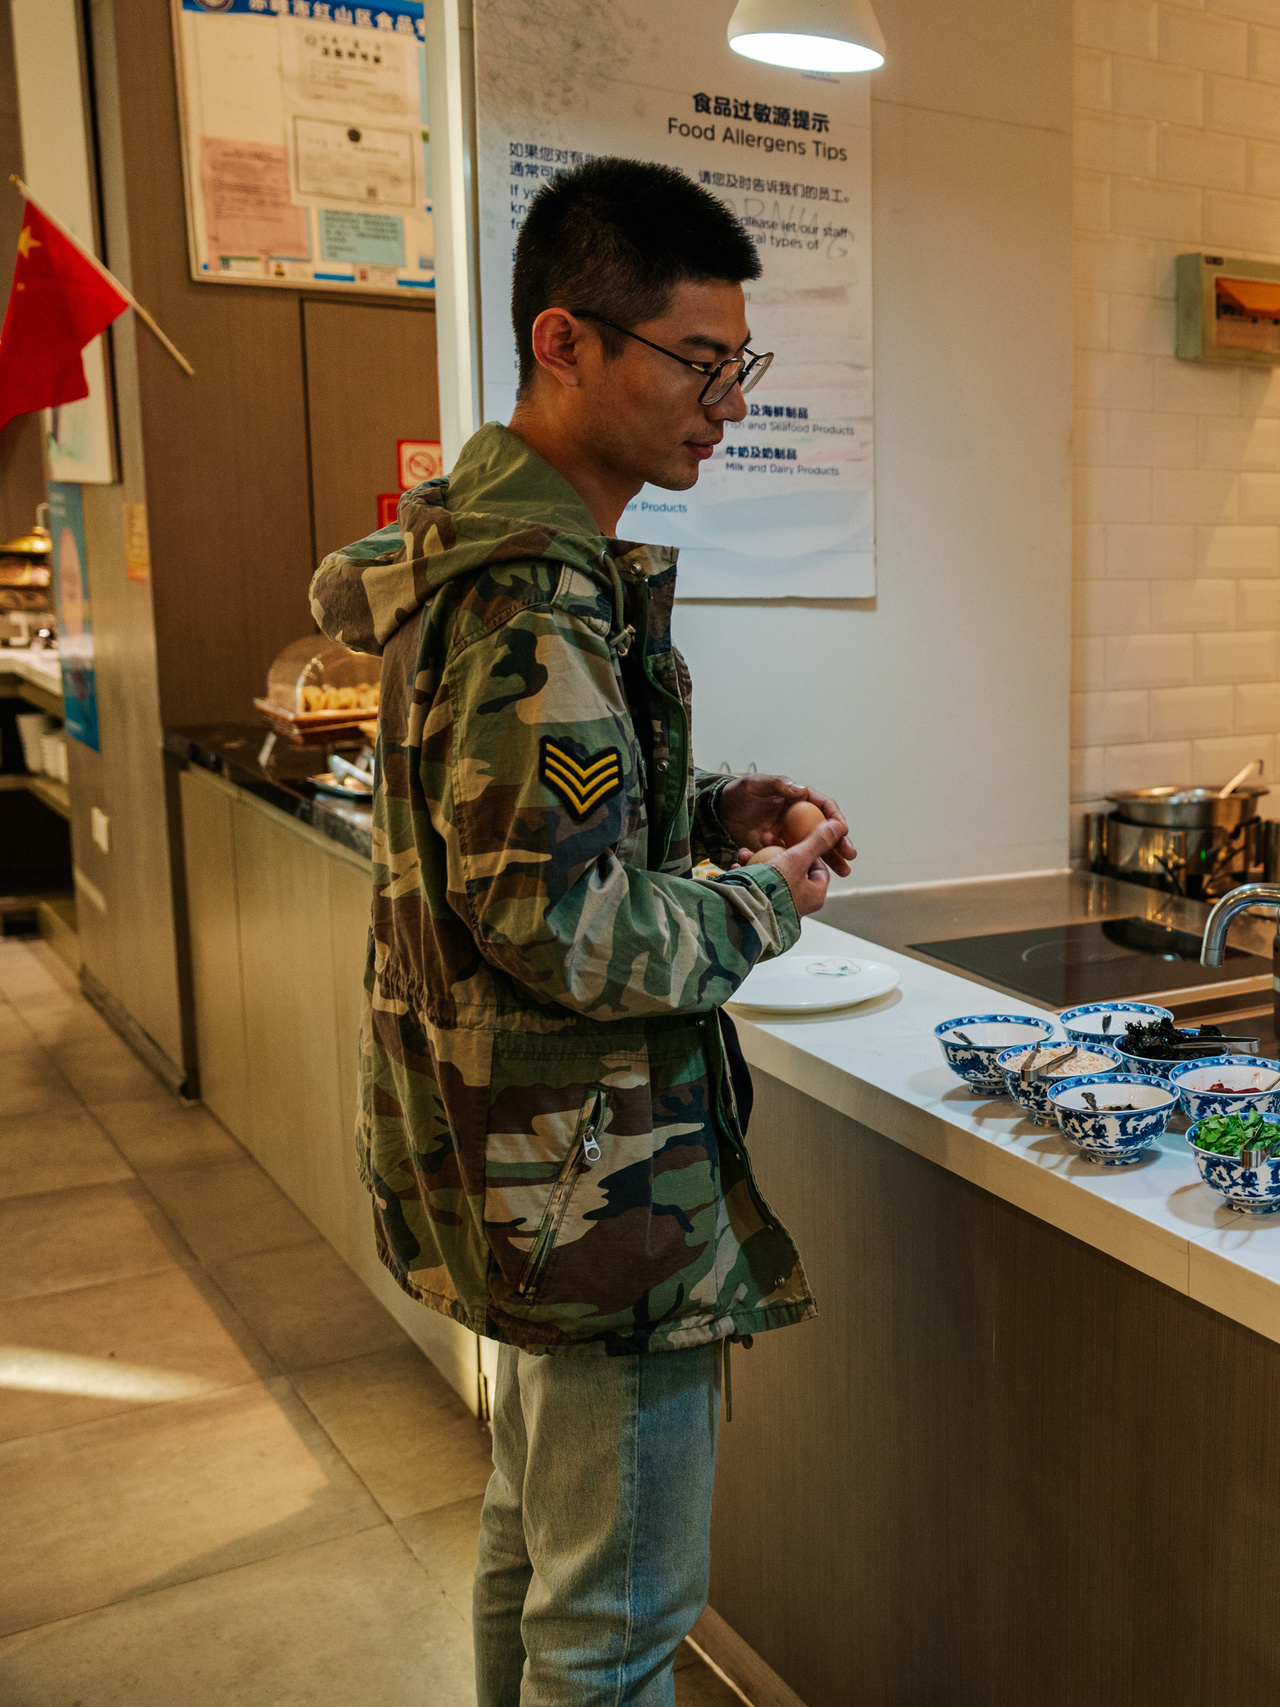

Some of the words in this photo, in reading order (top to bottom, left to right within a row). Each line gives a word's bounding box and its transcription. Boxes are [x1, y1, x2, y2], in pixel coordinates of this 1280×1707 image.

[693, 92, 830, 133] 食品过敏源提示
[667, 117, 715, 141] Food
[722, 127, 806, 156] Allergens
[813, 140, 848, 162] Tips
[523, 188, 540, 199] yo
[782, 220, 796, 232] let
[801, 224, 819, 235] our
[823, 226, 848, 239] staff
[770, 234, 803, 249] types
[807, 239, 819, 250] of
[746, 404, 809, 420] 及海鲜制品
[748, 421, 767, 431] and
[770, 421, 810, 433] Seafood
[813, 424, 855, 436] Products
[726, 462, 744, 472] Milk
[748, 462, 767, 473] and
[770, 464, 795, 475] Dairy
[797, 465, 840, 477] Products
[641, 501, 688, 513] Products
